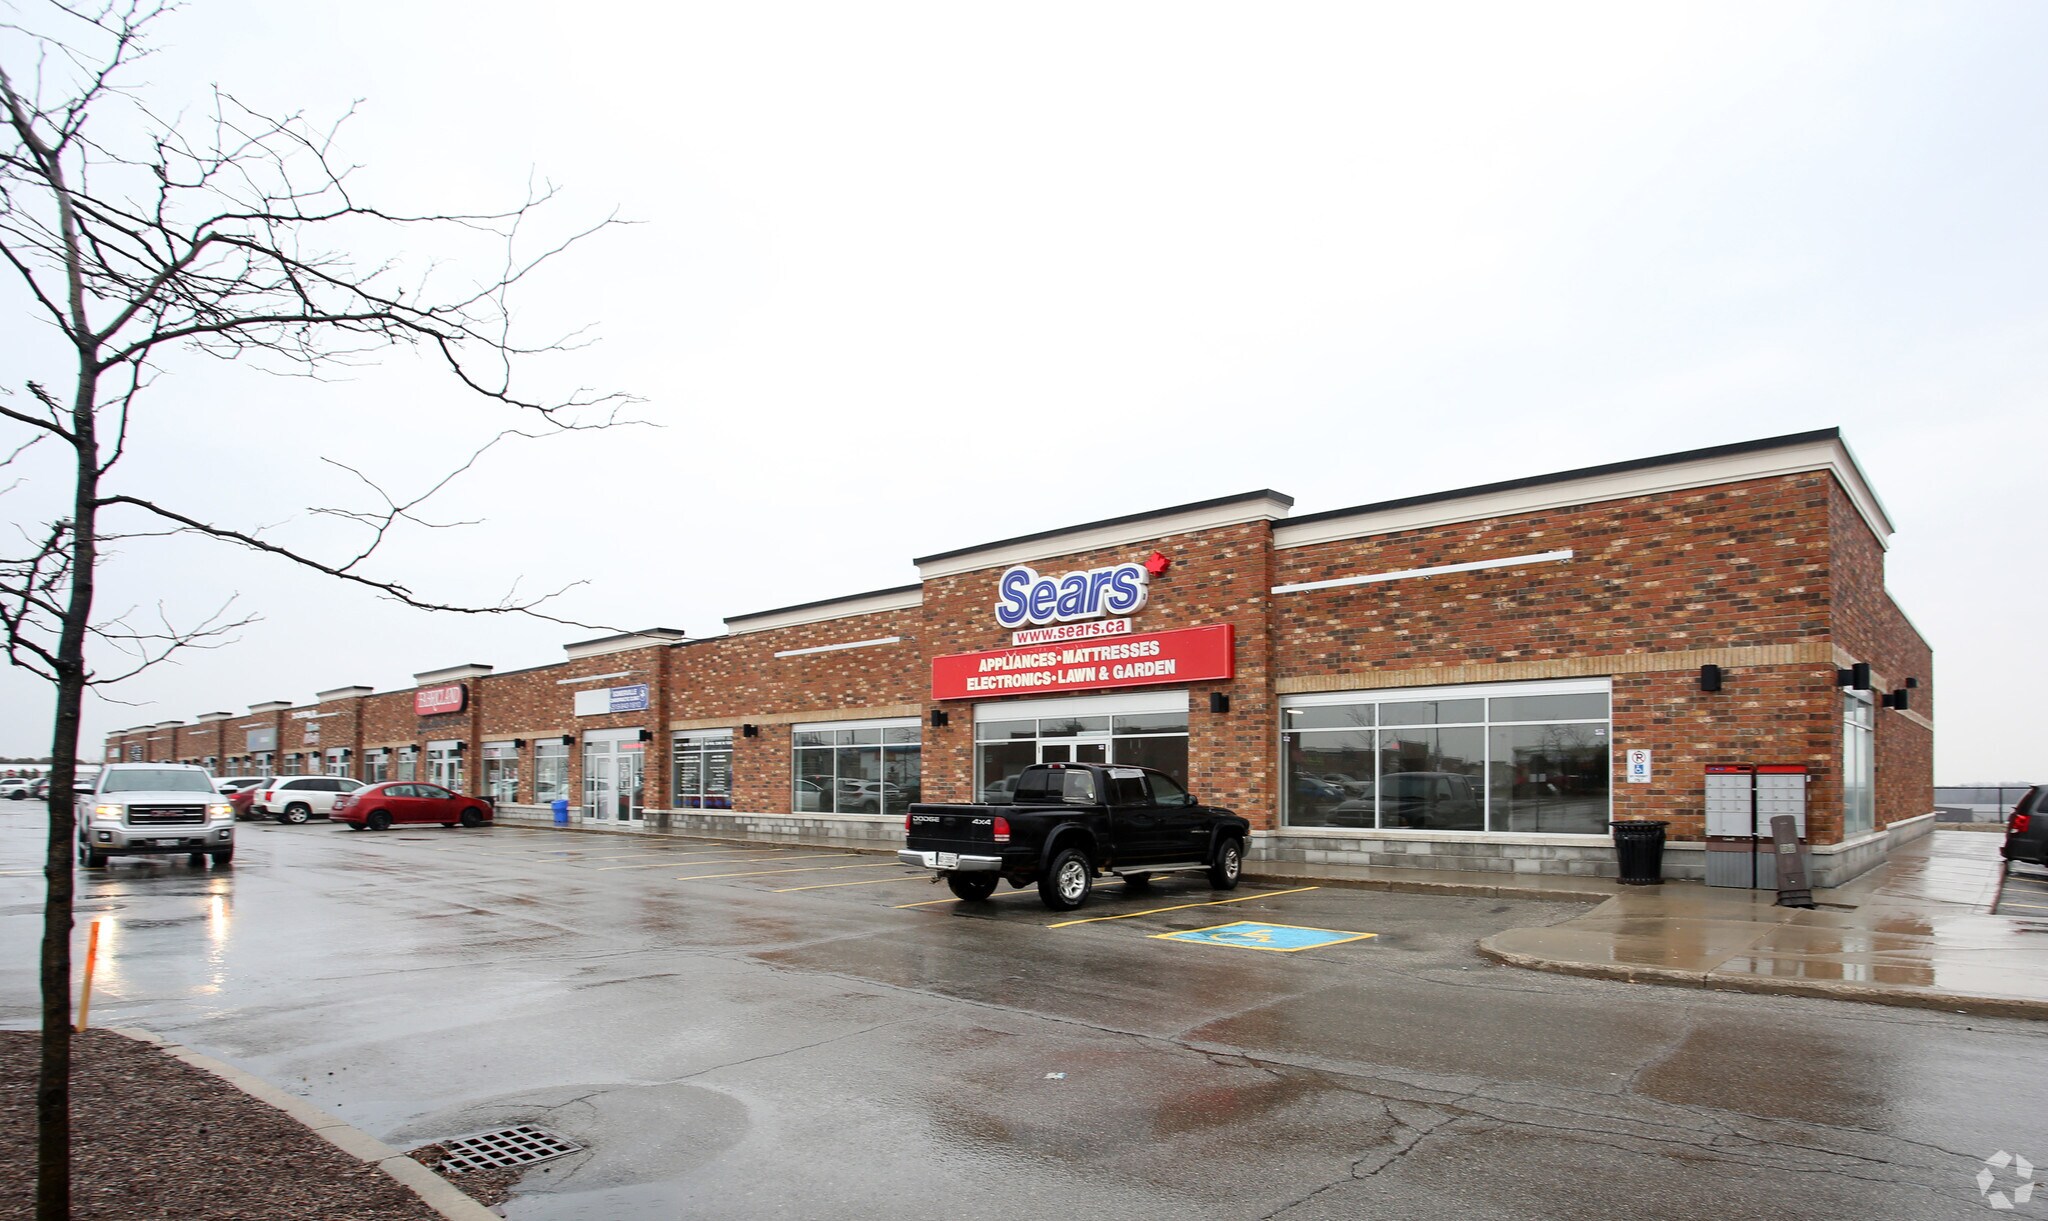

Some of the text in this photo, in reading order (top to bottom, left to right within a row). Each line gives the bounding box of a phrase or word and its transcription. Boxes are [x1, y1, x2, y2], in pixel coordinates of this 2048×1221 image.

[997, 566, 1141, 624] Sears
[1016, 619, 1126, 644] www.sears.ca
[1098, 666, 1110, 681] &
[1112, 658, 1176, 680] GARDEN
[912, 815, 940, 823] DODGE
